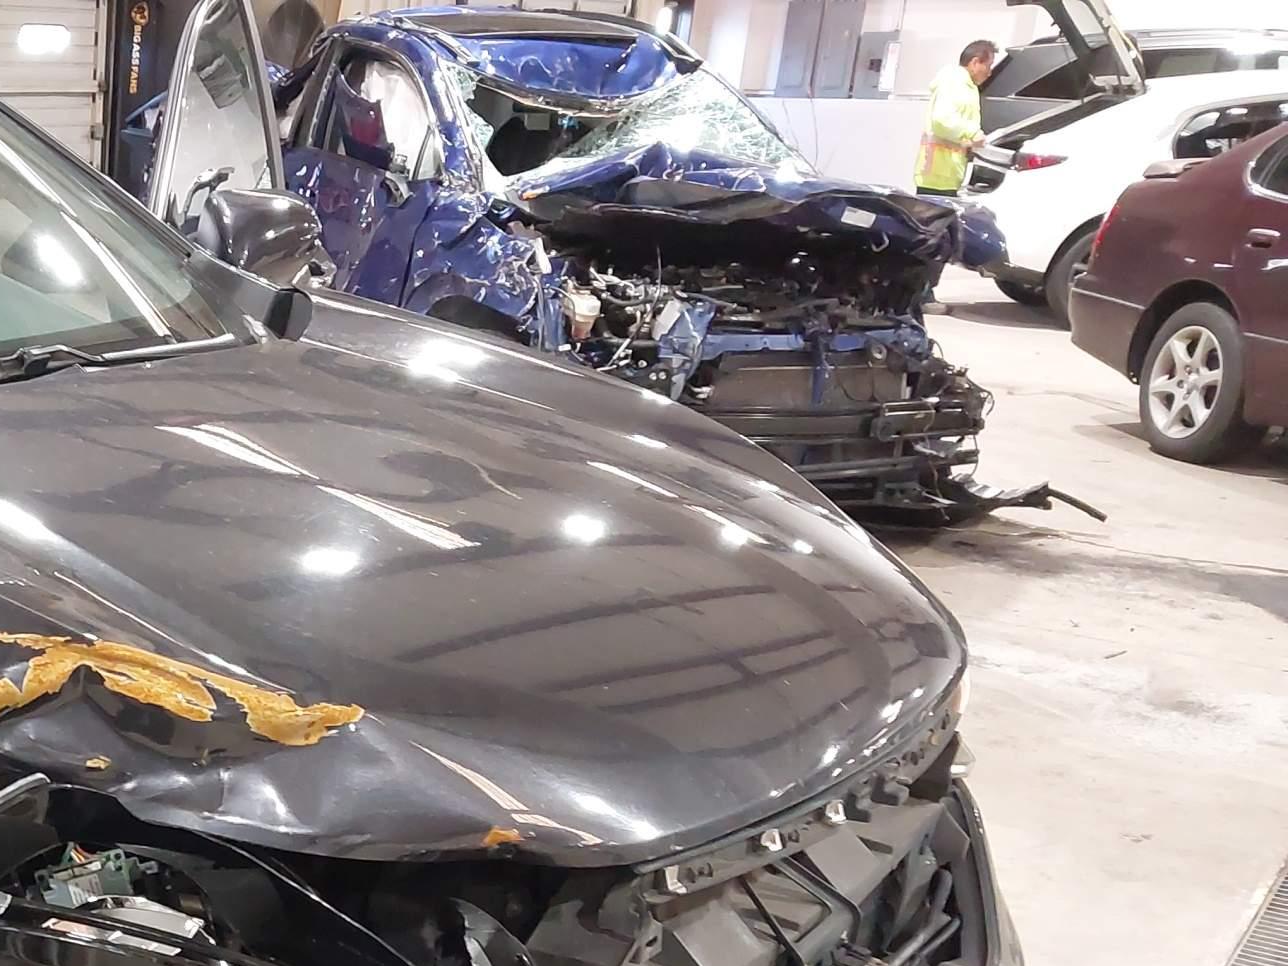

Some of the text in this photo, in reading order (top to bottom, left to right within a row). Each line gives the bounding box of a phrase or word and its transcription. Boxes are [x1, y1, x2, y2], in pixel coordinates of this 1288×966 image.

[129, 24, 143, 94] BIG ASS FANS
